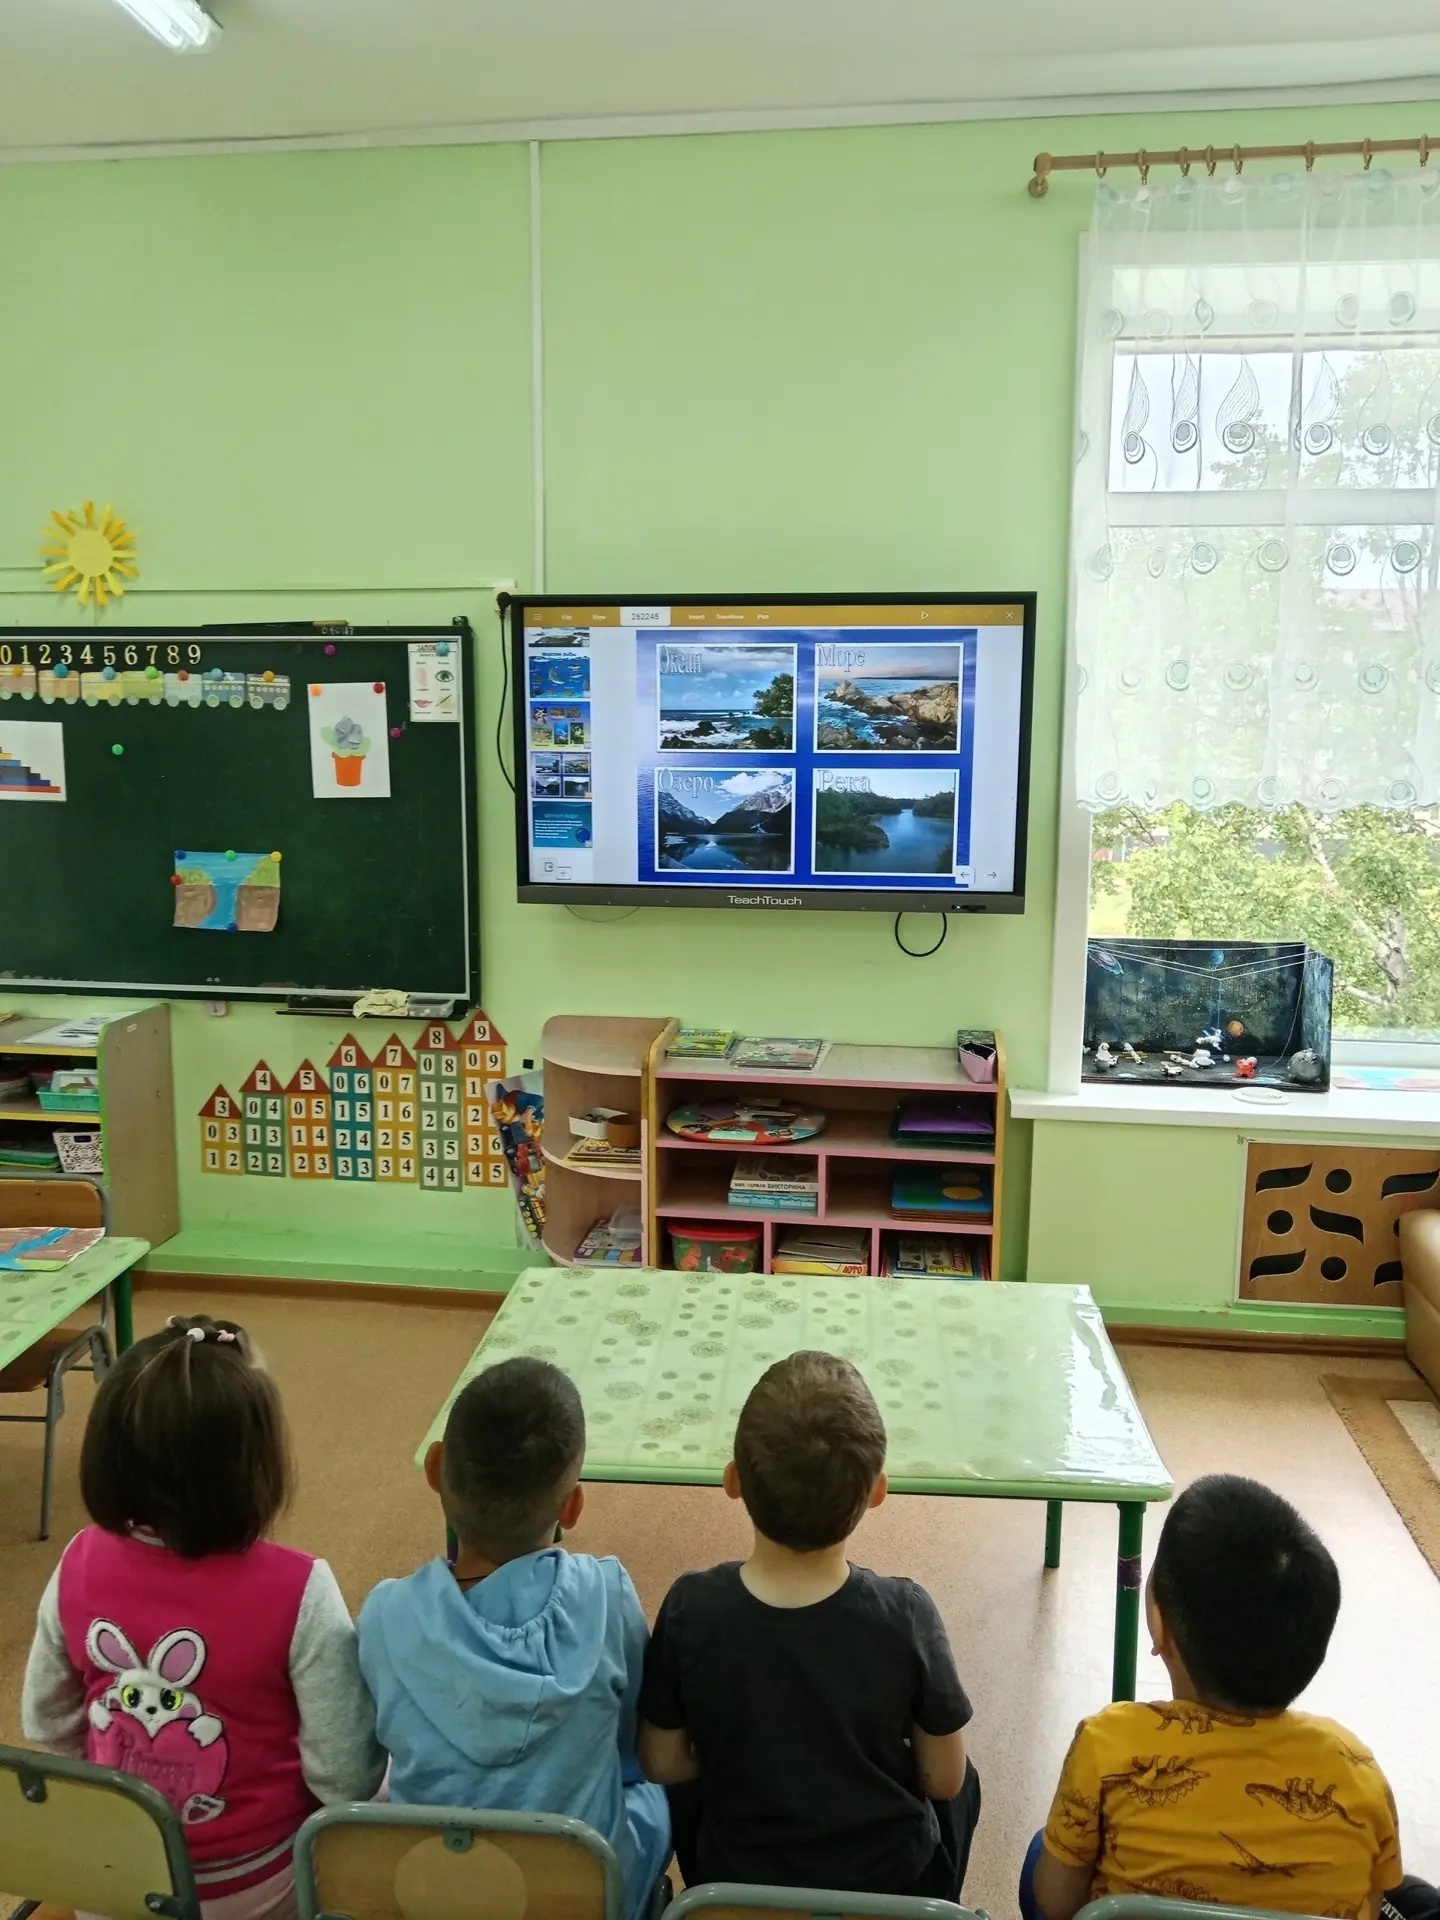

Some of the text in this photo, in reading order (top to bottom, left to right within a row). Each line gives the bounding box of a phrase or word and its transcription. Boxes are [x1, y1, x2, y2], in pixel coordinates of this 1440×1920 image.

[0, 644, 201, 665] 0 1 2 3 4 5 6 7 8 9
[659, 645, 702, 674] Океан
[816, 644, 866, 672] Море
[658, 768, 714, 798] Озеро
[816, 769, 872, 794] Река
[727, 895, 802, 906] TeachTouch
[432, 1030, 442, 1045] 8
[477, 1025, 487, 1039] 9
[343, 1049, 354, 1063] 6
[389, 1048, 399, 1063] 7
[468, 1052, 499, 1068] 0 9
[423, 1057, 454, 1073] 0 8
[258, 1072, 268, 1086] 4
[302, 1071, 312, 1085] 5
[336, 1075, 367, 1090] 0 6
[379, 1075, 411, 1091] 0 7
[425, 1085, 455, 1100] 1 7
[470, 1081, 477, 1095] 1
[217, 1100, 227, 1114] 3
[249, 1100, 278, 1115] 0 4
[294, 1100, 324, 1115] 0 5
[339, 1104, 368, 1118] 1 5
[383, 1104, 411, 1119] 1 6
[425, 1113, 455, 1129] 2 6
[471, 1108, 480, 1122] 2
[208, 1124, 238, 1140] 0 3
[251, 1128, 278, 1143] 1 3
[295, 1128, 325, 1143] 1 4
[339, 1132, 369, 1146] 2 4
[381, 1131, 411, 1146] 2 5
[425, 1141, 456, 1156] 3 5
[470, 1137, 501, 1152] 3 6
[210, 1152, 238, 1167] 1 2
[250, 1154, 279, 1170] 2 2
[297, 1156, 327, 1171] 2 3
[340, 1159, 370, 1175] 3 3
[381, 1159, 411, 1174] 3 4
[426, 1167, 455, 1182] 4 4
[471, 1164, 502, 1179] 4 5
